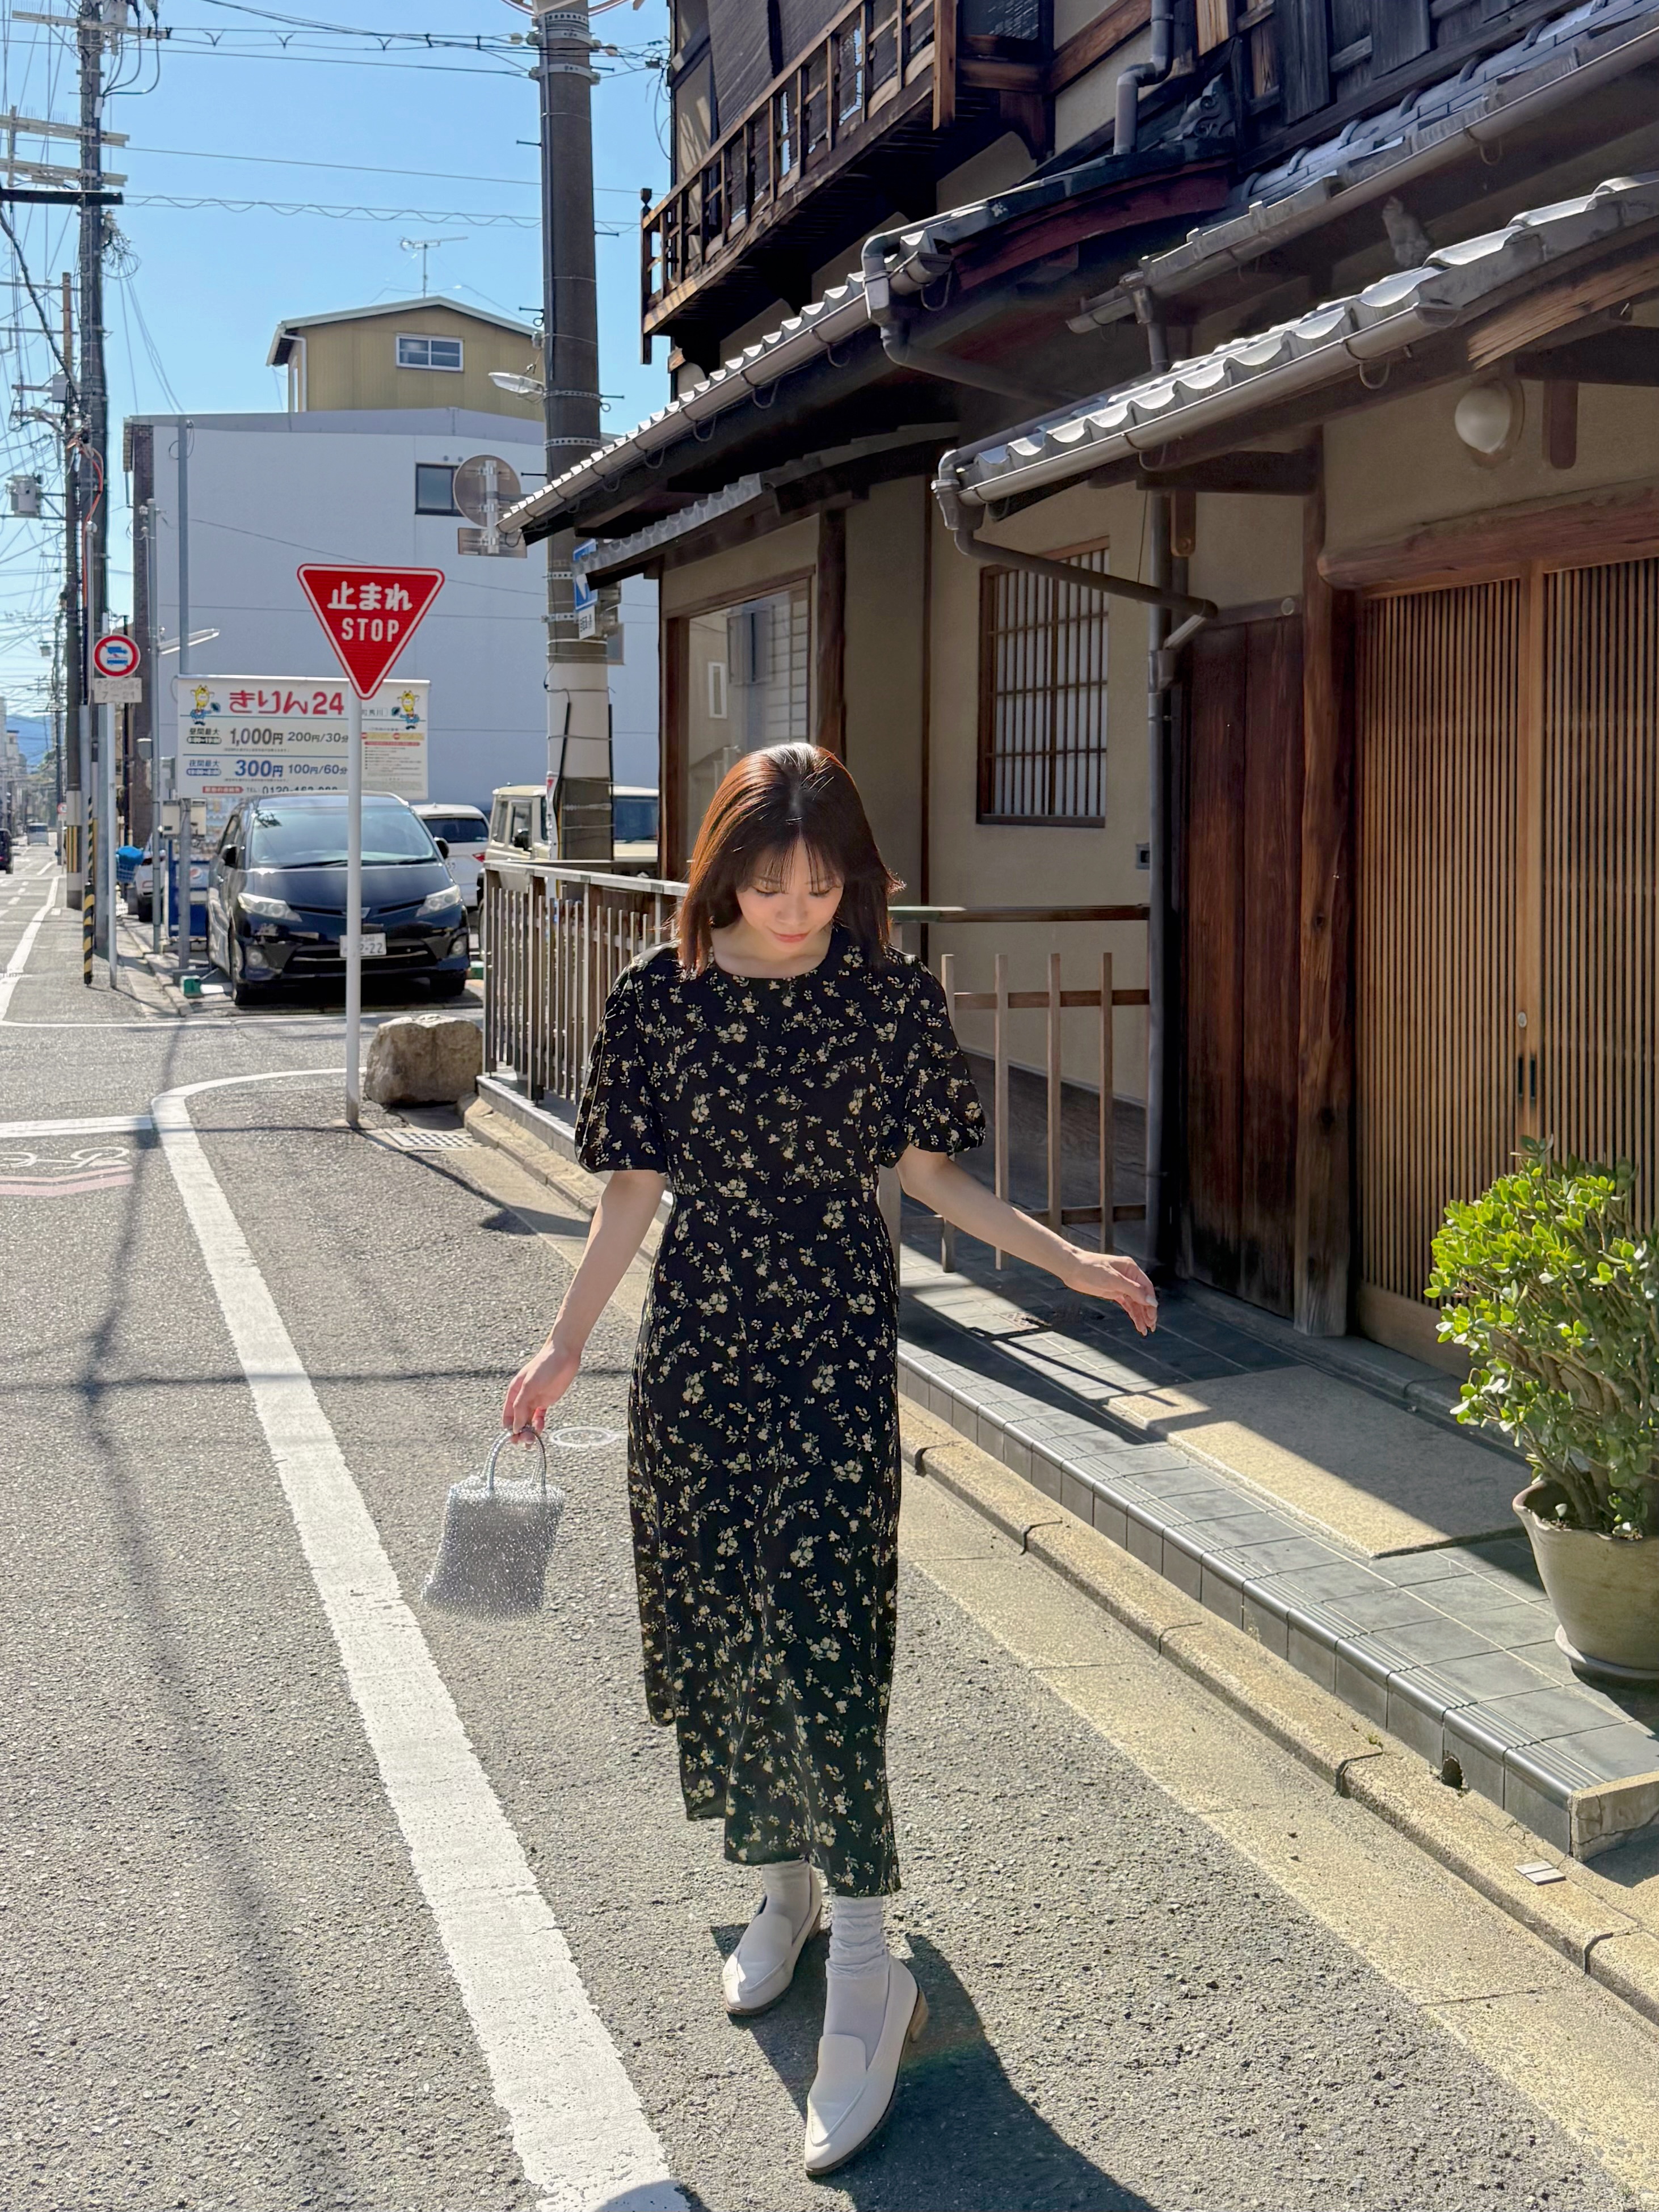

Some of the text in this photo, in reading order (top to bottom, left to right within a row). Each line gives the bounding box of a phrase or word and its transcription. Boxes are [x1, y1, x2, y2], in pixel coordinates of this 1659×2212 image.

[327, 580, 413, 611] 止まれ
[342, 617, 399, 642] STOP
[229, 690, 344, 715] きりん24
[230, 728, 283, 746] 1,000円
[287, 731, 348, 743] 200円/30分
[234, 759, 348, 777] 300円 100円/60分
